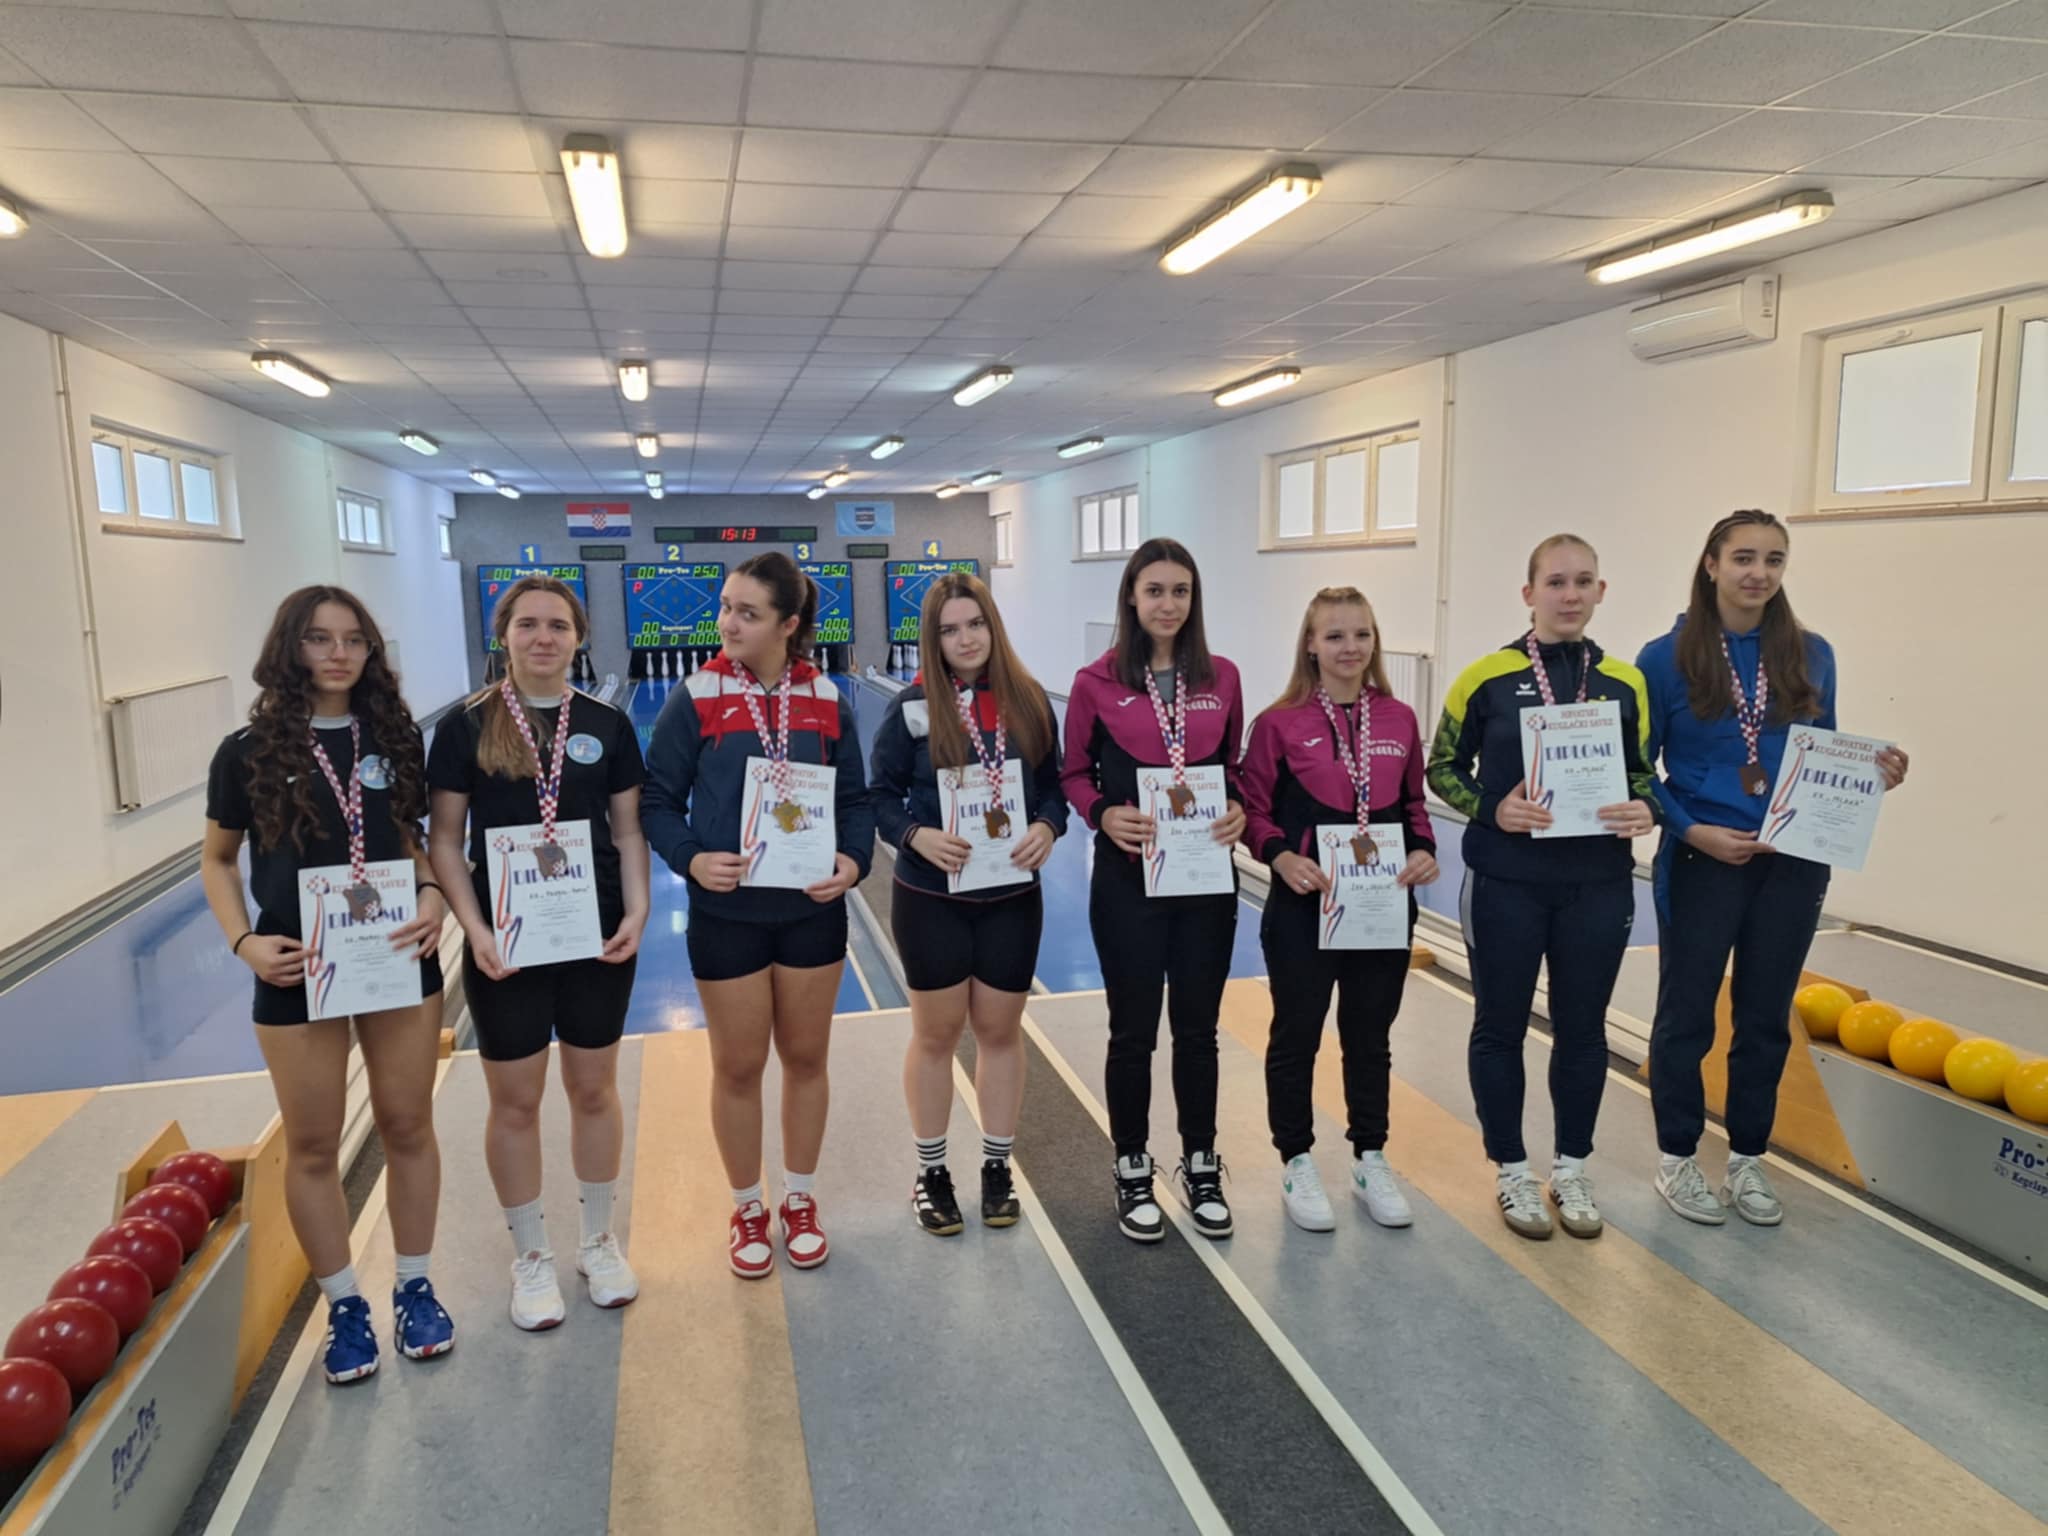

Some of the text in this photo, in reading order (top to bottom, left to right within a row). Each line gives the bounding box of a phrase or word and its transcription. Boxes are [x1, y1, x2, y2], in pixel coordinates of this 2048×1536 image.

[720, 528, 758, 541] 15:13
[524, 546, 535, 562] 1
[668, 544, 680, 560] 2
[798, 544, 810, 560] 3
[927, 542, 938, 557] 4
[633, 581, 644, 594] P
[895, 578, 904, 590] P
[634, 634, 661, 646] 000
[1546, 742, 1616, 760] DIPLOMU
[1802, 768, 1877, 796] DIPLOMU
[1999, 1136, 2048, 1168] Pro-
